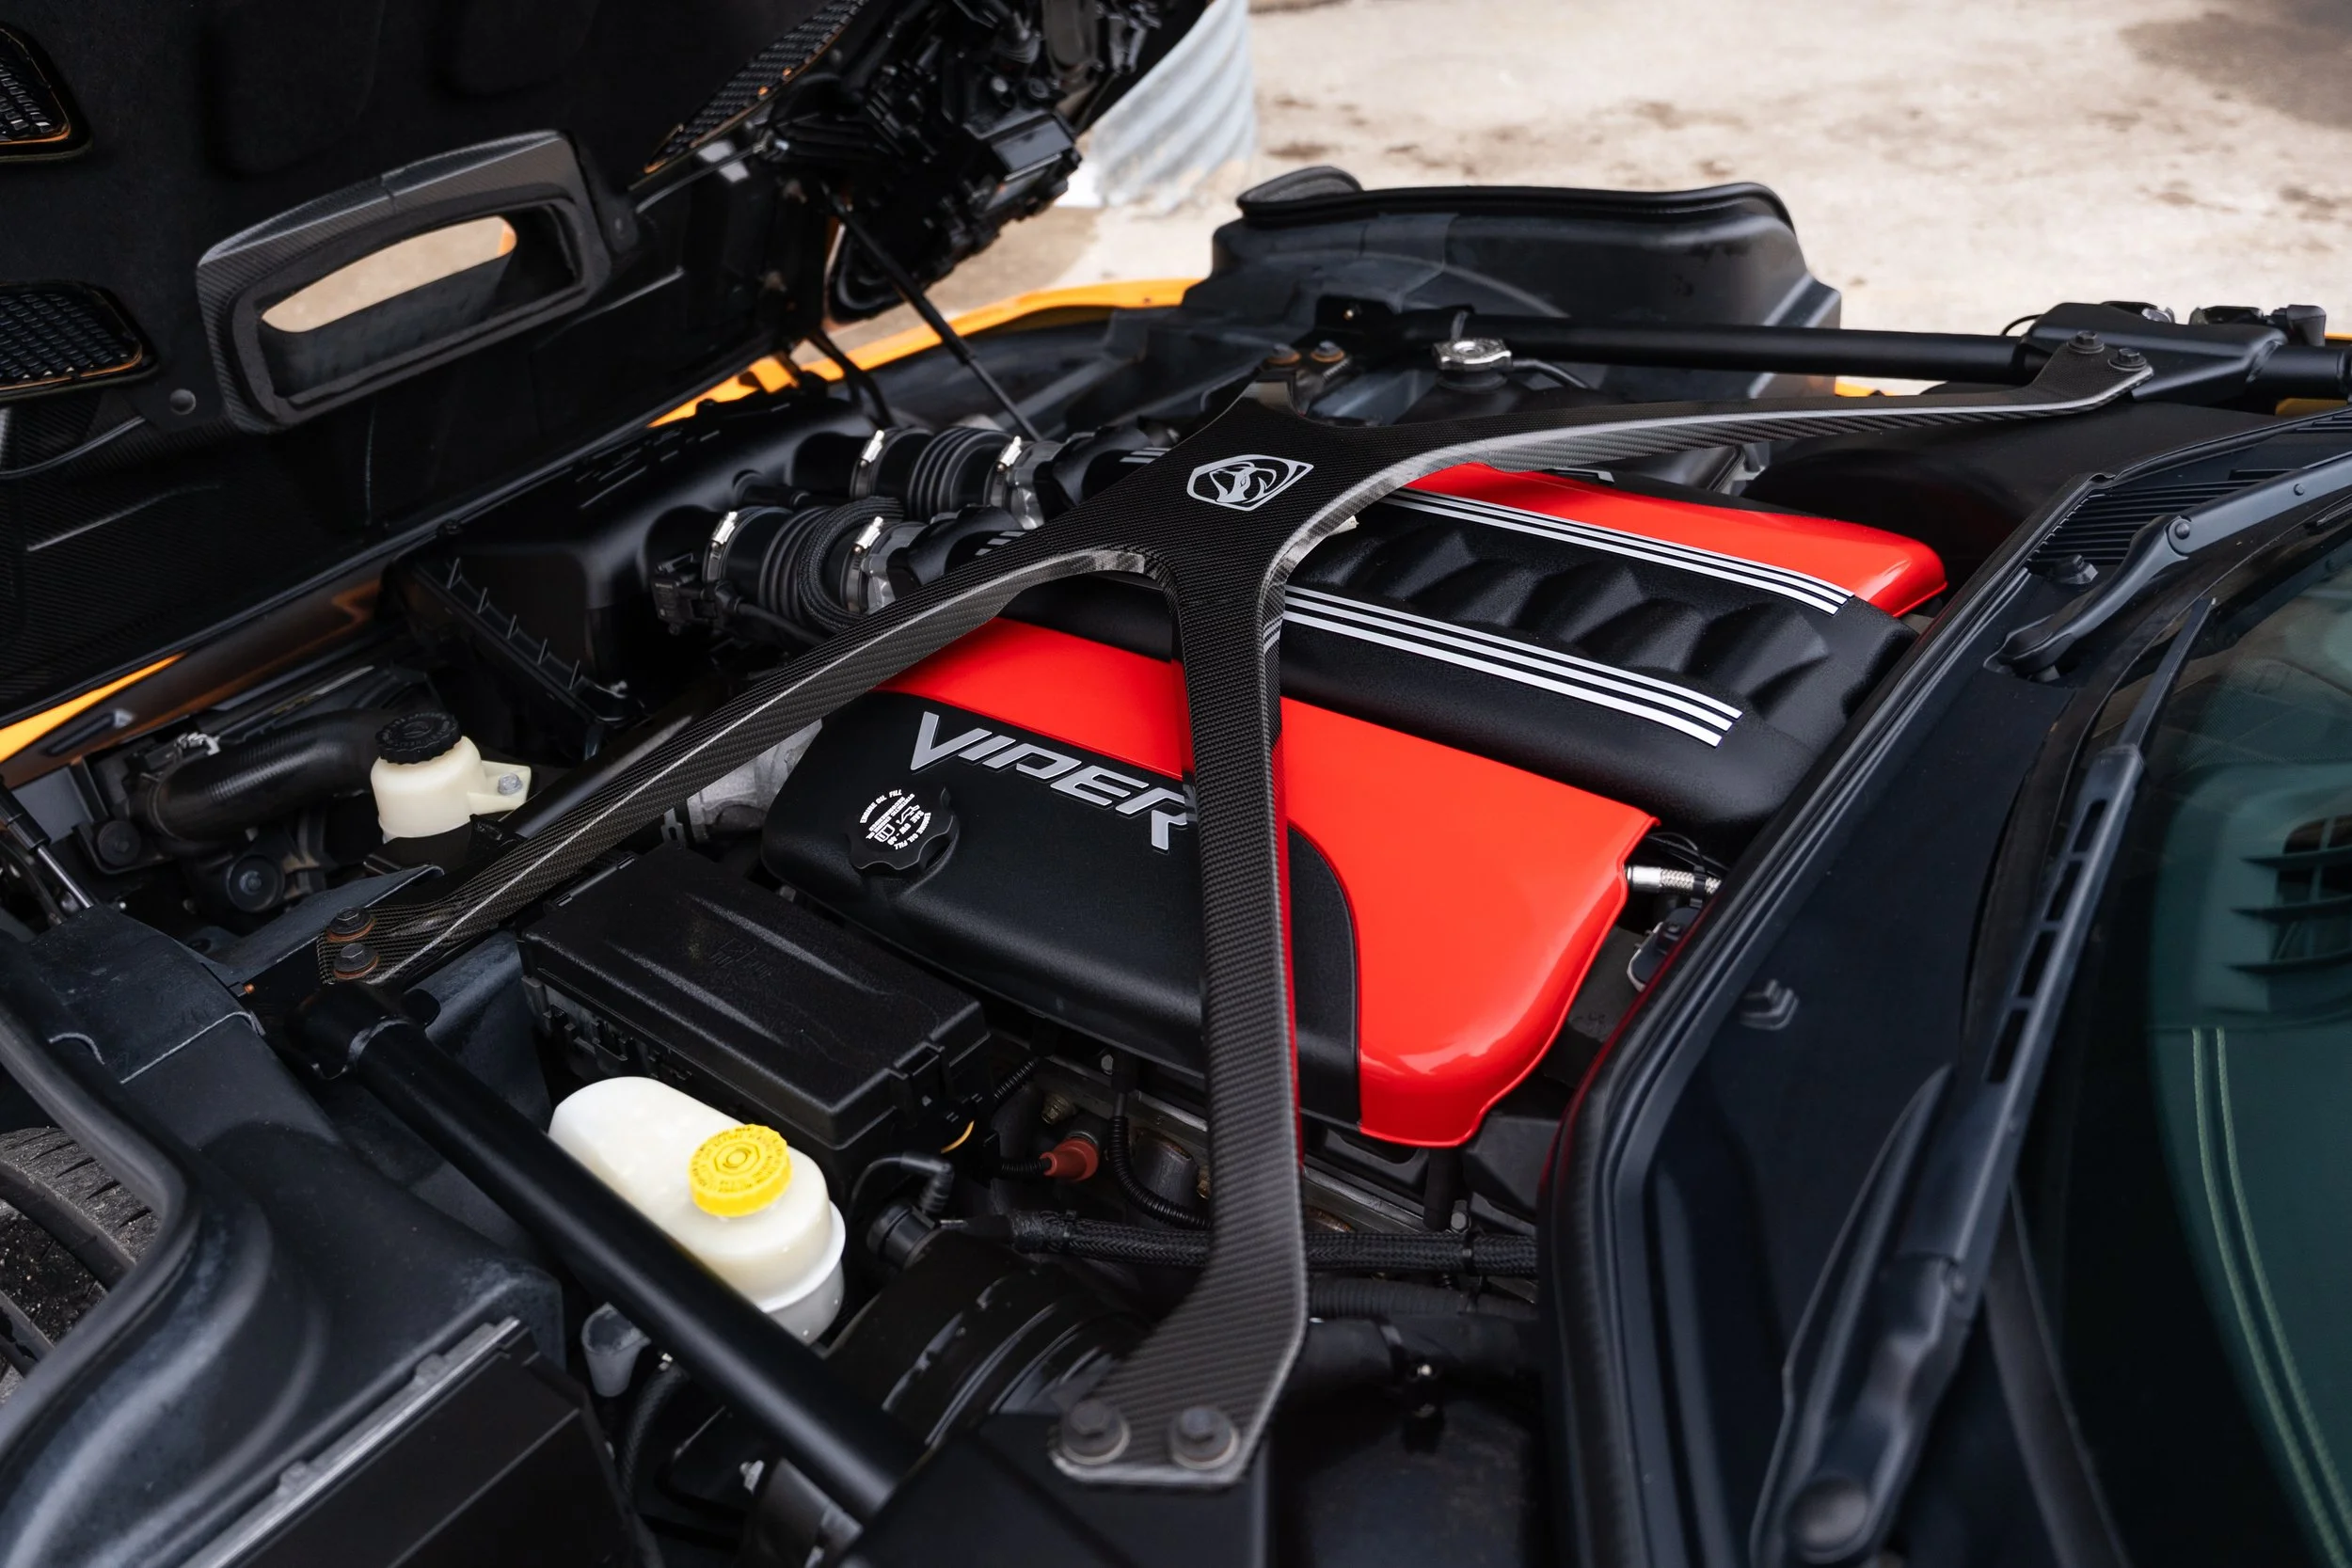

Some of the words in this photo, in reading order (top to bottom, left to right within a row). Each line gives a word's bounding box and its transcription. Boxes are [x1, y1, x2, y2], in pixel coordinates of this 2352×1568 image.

[910, 710, 1187, 850] VIPER
[860, 802, 877, 823] ENGINE
[876, 795, 887, 804] OIL
[889, 789, 902, 798] FILL
[910, 810, 925, 824] SAE
[916, 813, 931, 834] ENGINE
[887, 836, 898, 846] 40
[894, 840, 909, 850] FILL
[907, 834, 918, 845] OIL
